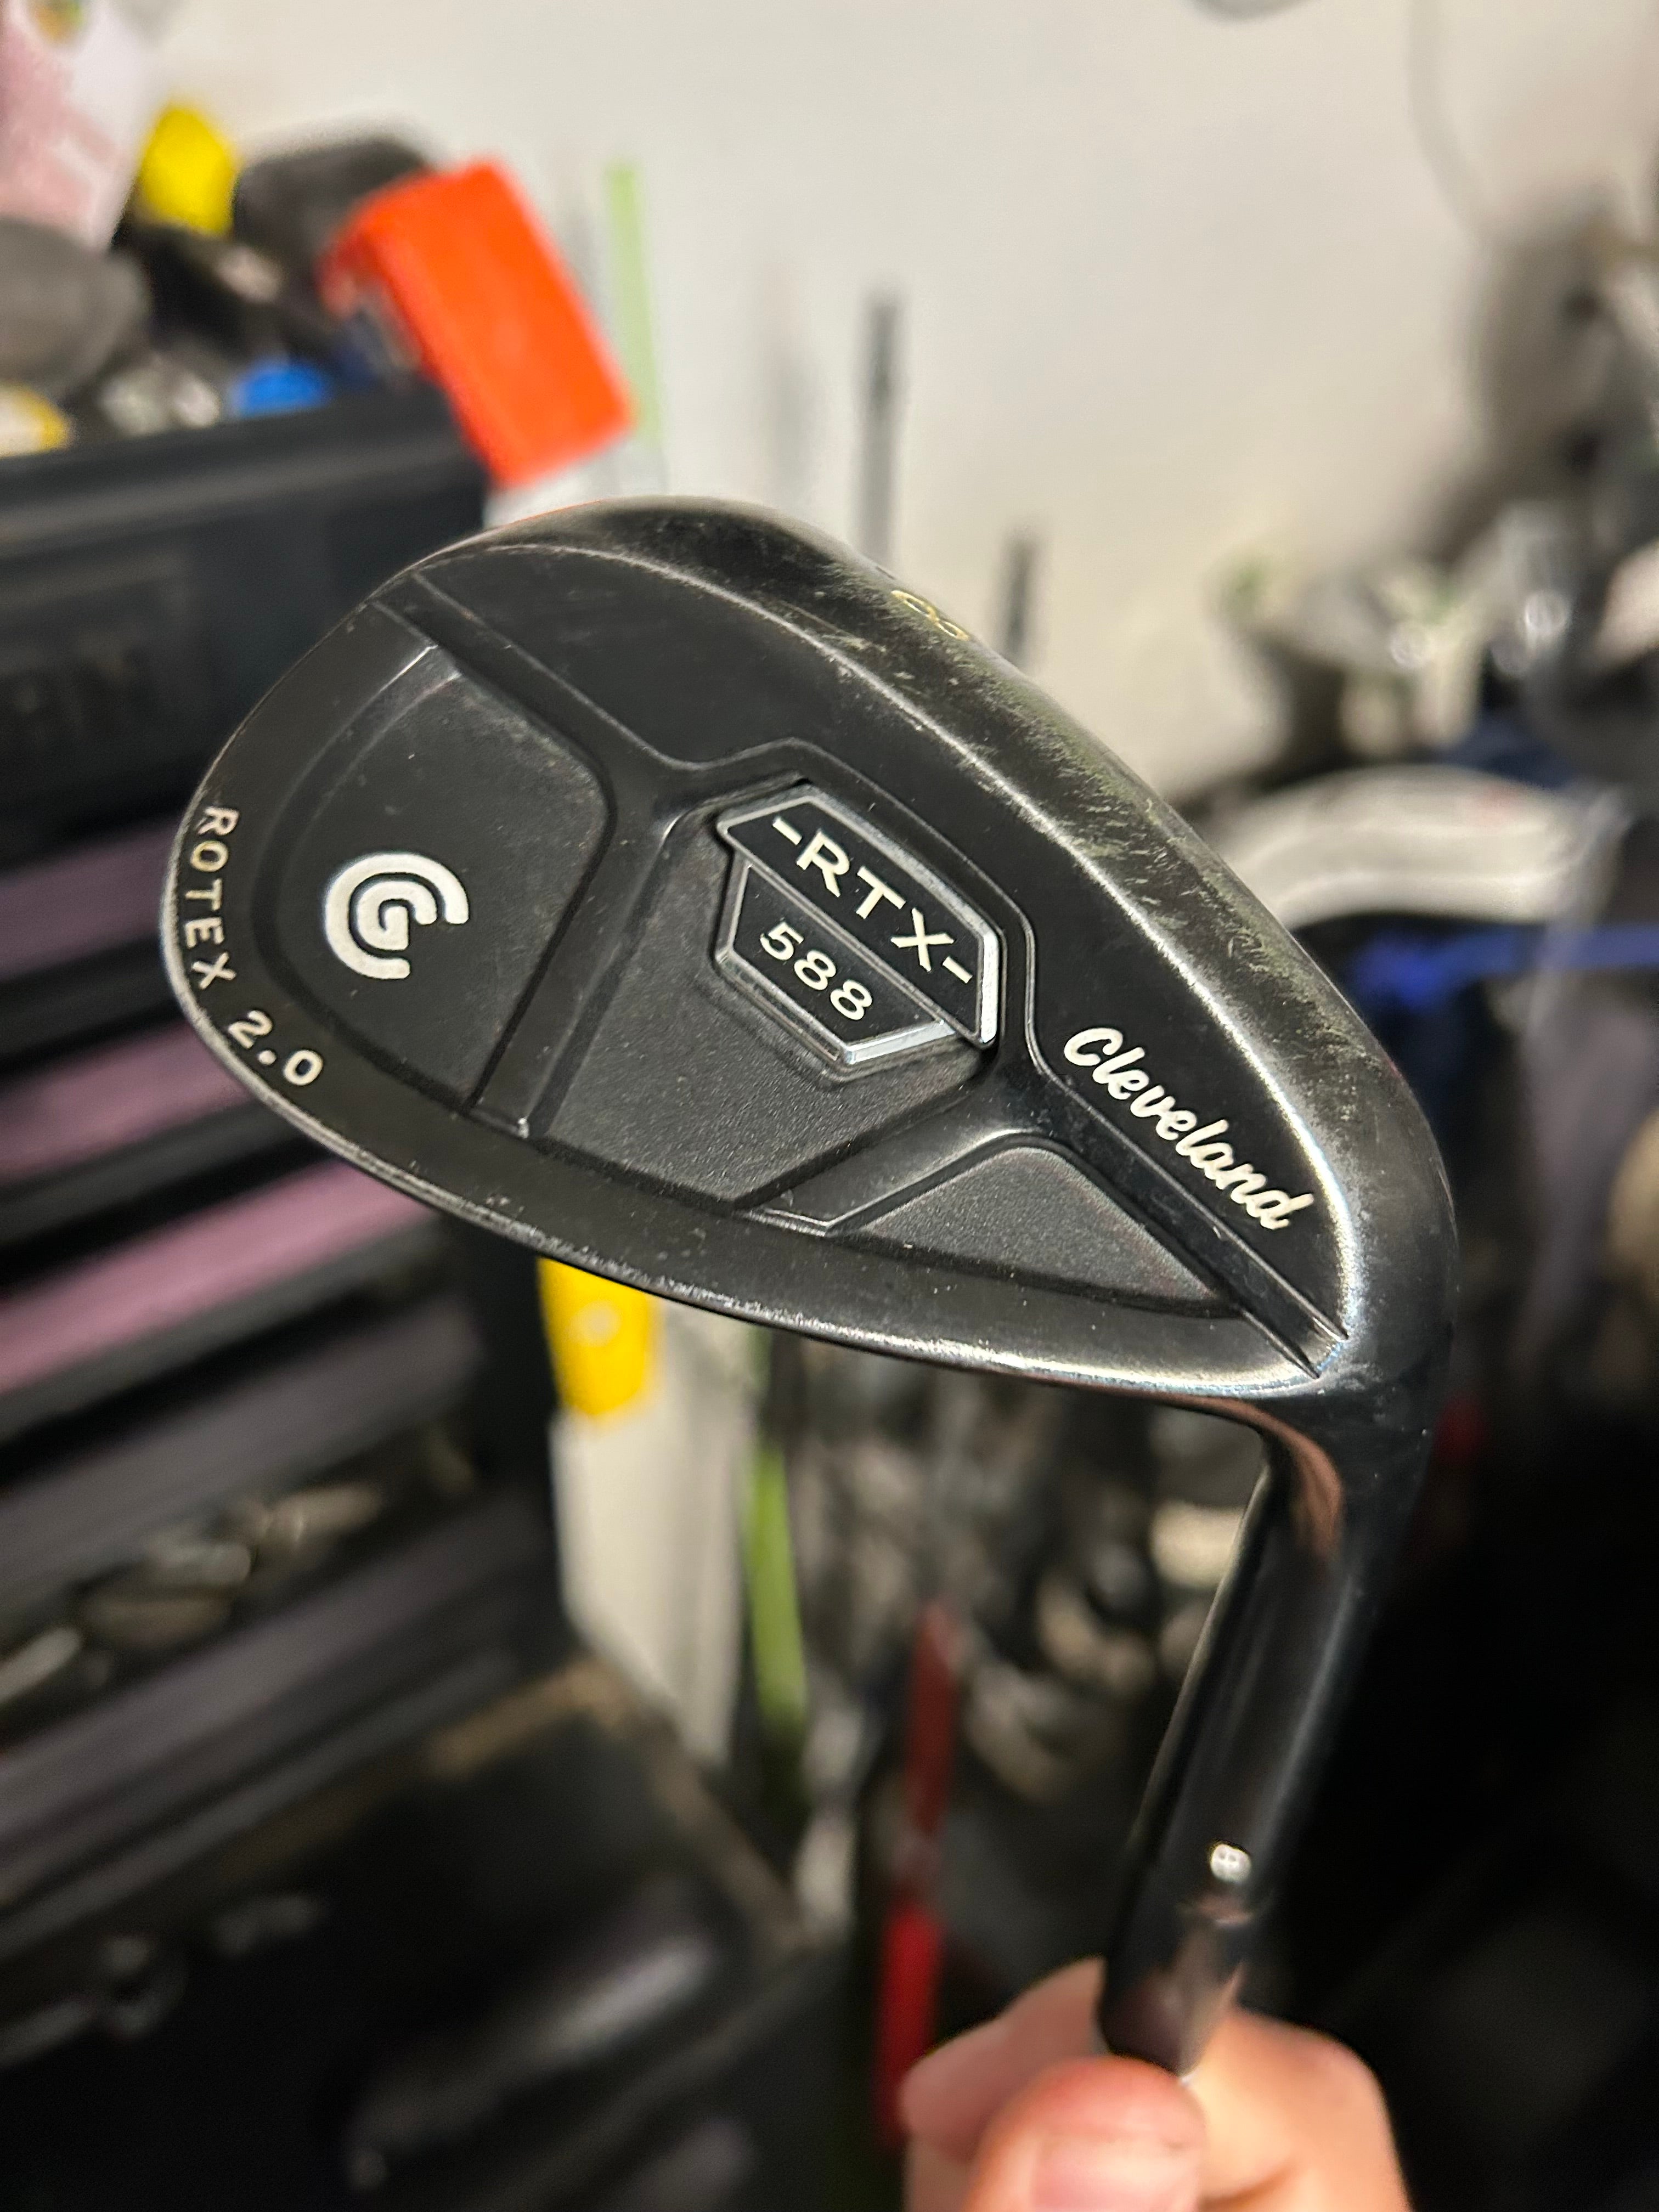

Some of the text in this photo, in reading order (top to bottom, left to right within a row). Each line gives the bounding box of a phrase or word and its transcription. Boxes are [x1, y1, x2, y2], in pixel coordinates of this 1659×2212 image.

[185, 806, 324, 1086] ROTEX 2.0
[760, 921, 873, 1021] 588
[1064, 1027, 1314, 1230] Cleveland
